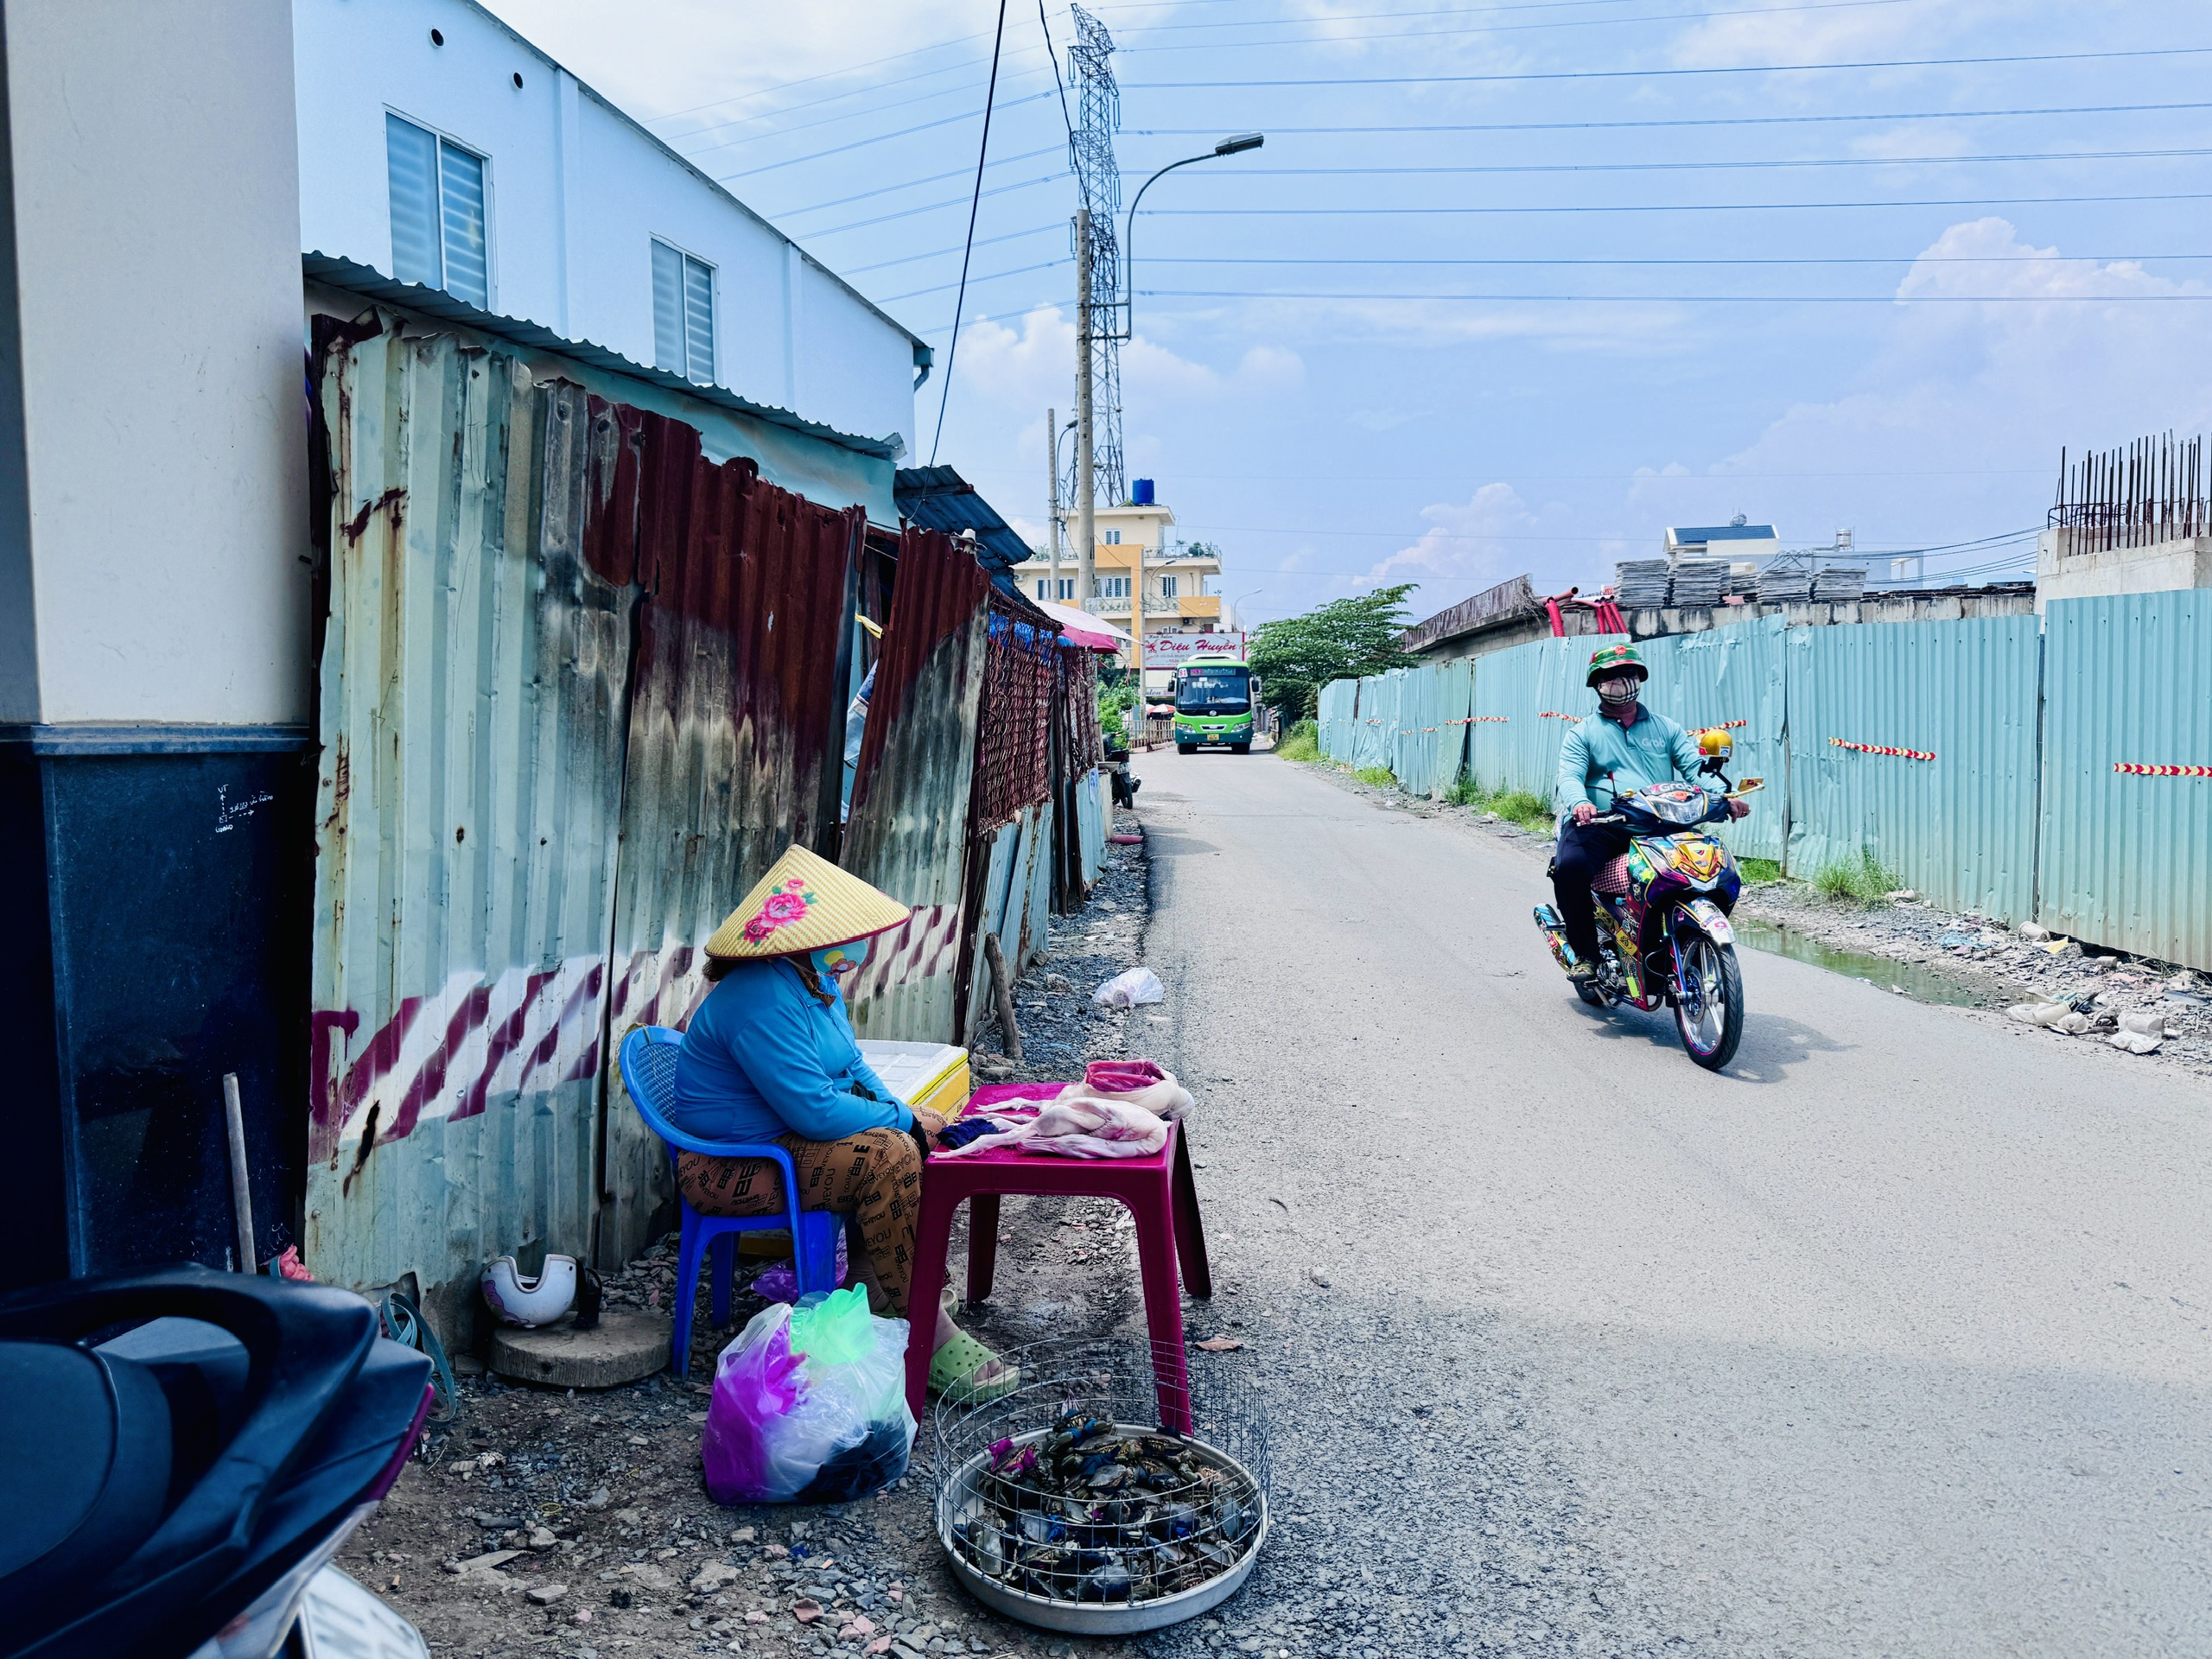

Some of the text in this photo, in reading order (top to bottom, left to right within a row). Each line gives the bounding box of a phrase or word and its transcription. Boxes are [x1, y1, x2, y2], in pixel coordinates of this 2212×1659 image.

[1160, 639, 1236, 653] Diệu Huyền
[1642, 738, 1665, 747] Grab
[1659, 782, 1694, 792] Grab
